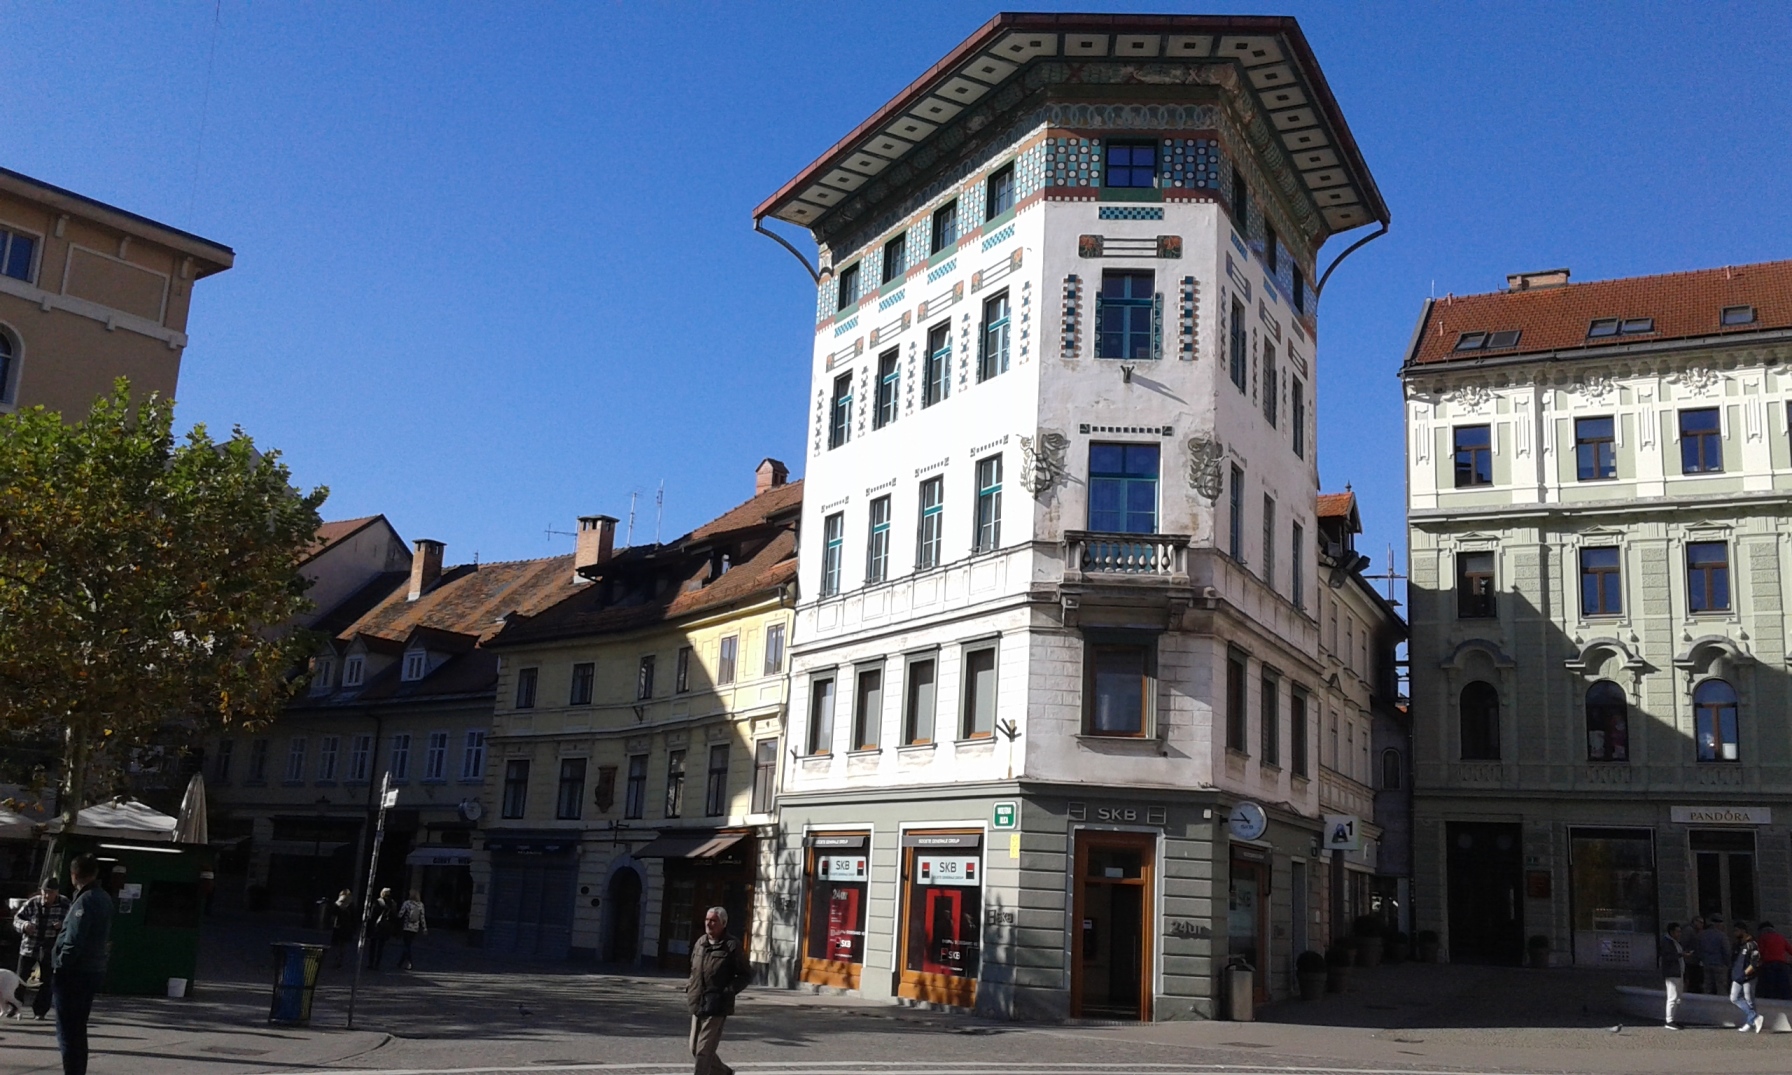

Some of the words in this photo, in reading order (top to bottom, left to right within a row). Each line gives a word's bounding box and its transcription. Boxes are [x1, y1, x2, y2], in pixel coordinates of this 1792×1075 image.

[1098, 808, 1137, 821] SKB
[1690, 811, 1750, 821] PANDORA
[1332, 821, 1353, 843] A1
[836, 860, 850, 871] SKB
[939, 862, 957, 873] SKB
